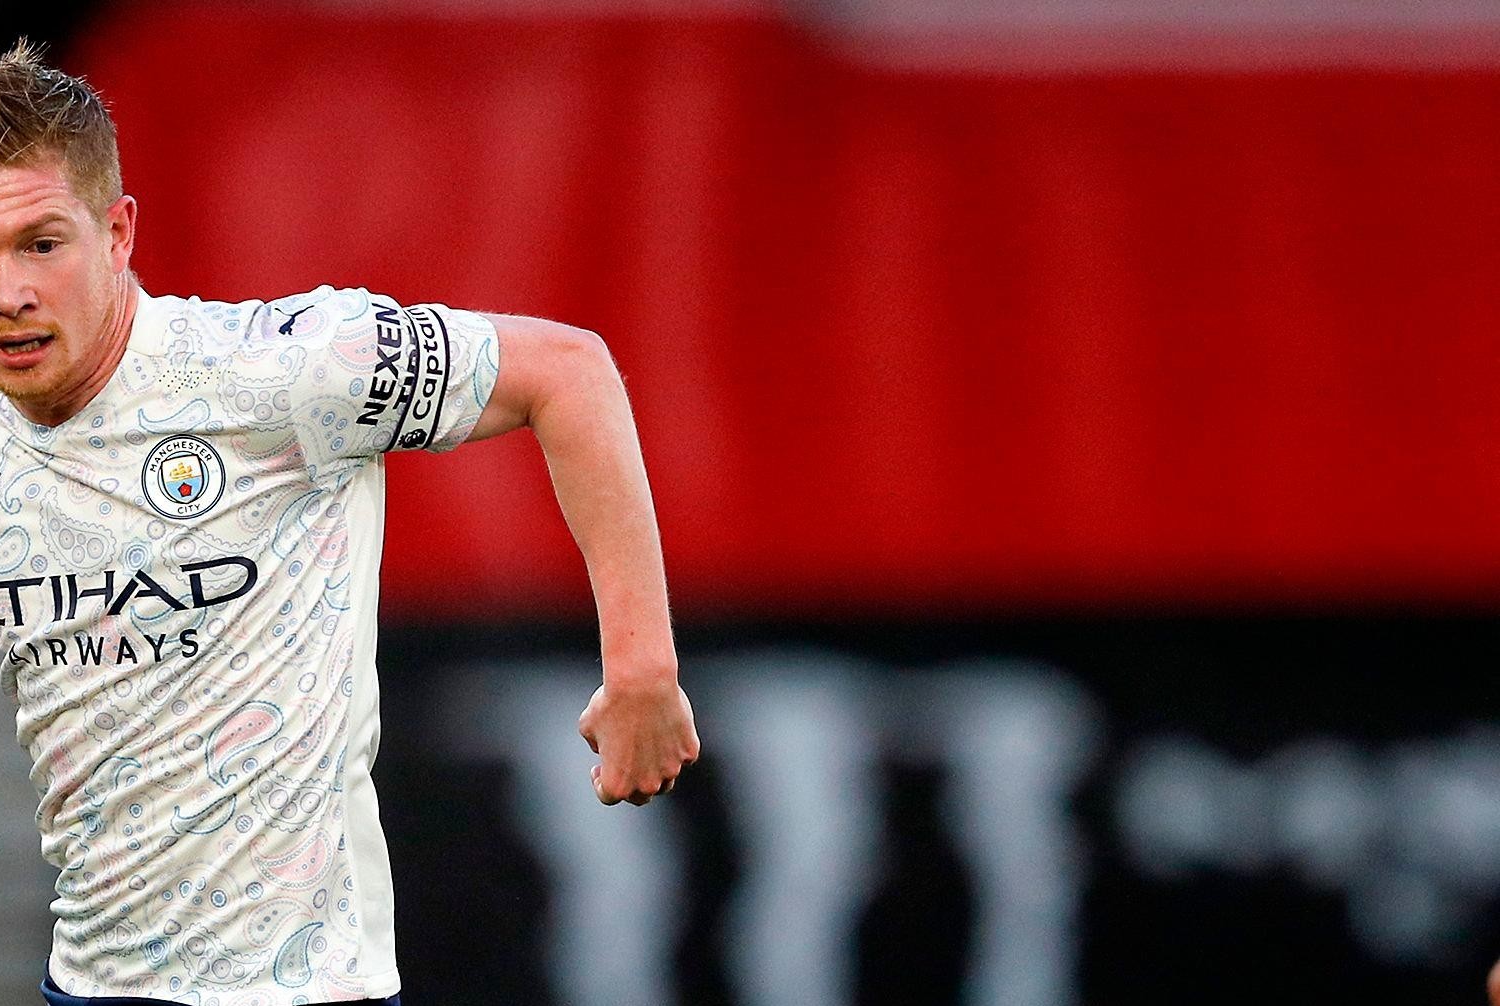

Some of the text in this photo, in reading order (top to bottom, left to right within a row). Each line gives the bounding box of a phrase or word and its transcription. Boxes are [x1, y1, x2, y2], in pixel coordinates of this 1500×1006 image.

[356, 302, 402, 426] NEXEN
[405, 307, 443, 420] Captain
[149, 440, 213, 473] MANCHESTER
[177, 503, 201, 515] CITY
